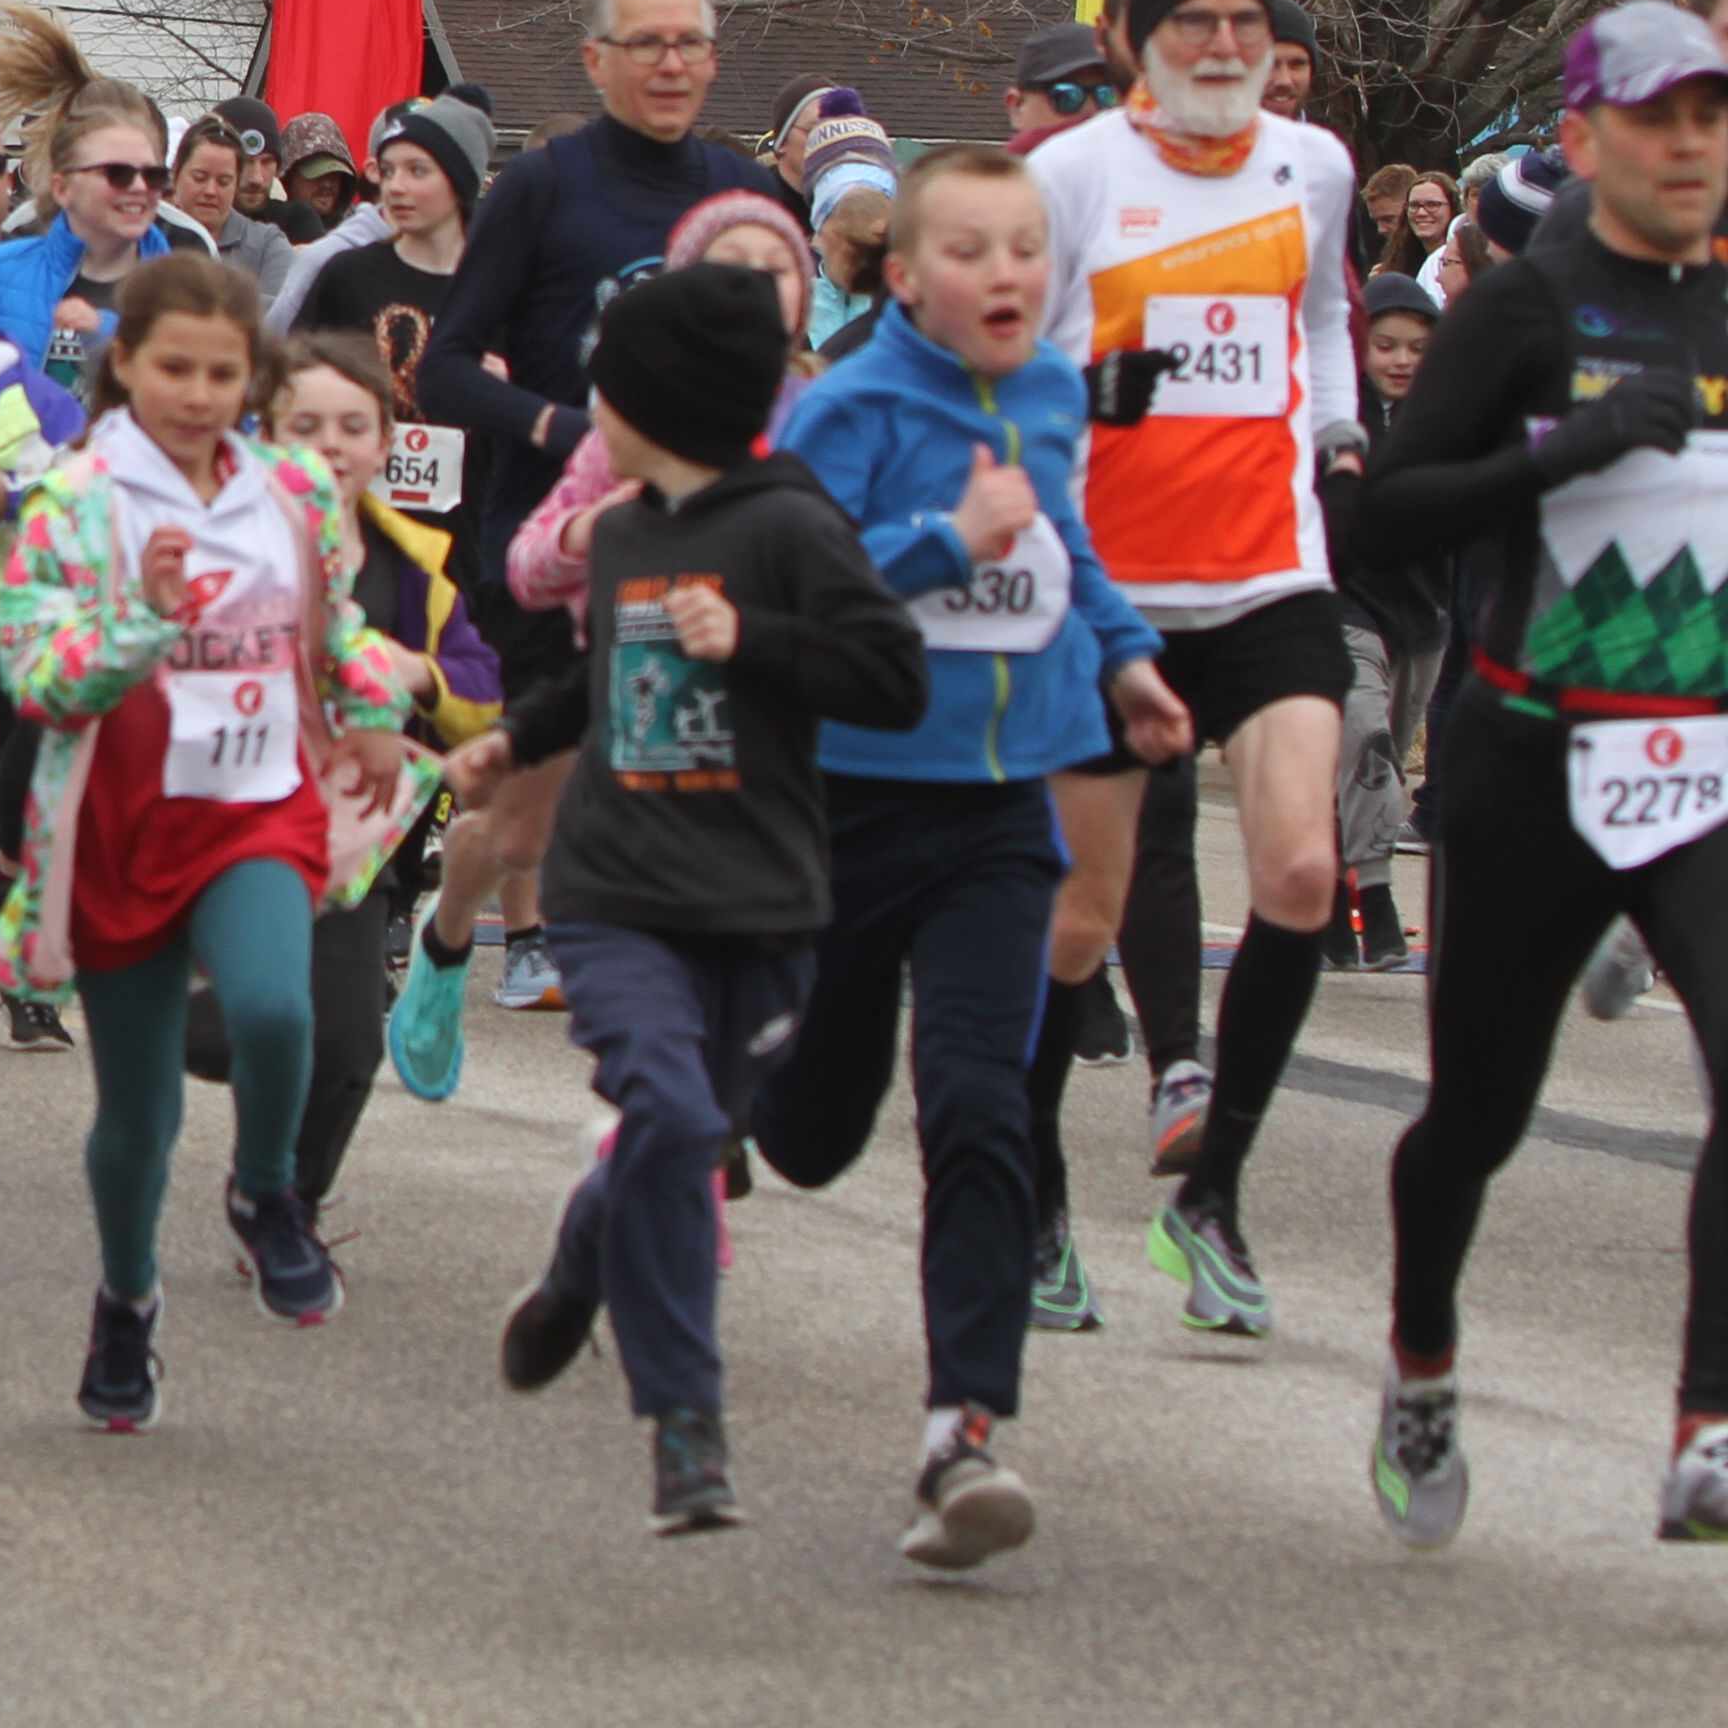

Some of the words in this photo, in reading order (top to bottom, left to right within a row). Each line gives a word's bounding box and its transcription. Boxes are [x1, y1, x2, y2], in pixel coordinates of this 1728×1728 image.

[1168, 341, 1262, 385] 2431
[384, 455, 440, 488] 654
[164, 623, 297, 670] OCKET
[211, 725, 271, 767] 111
[1601, 774, 1722, 828] 2278
